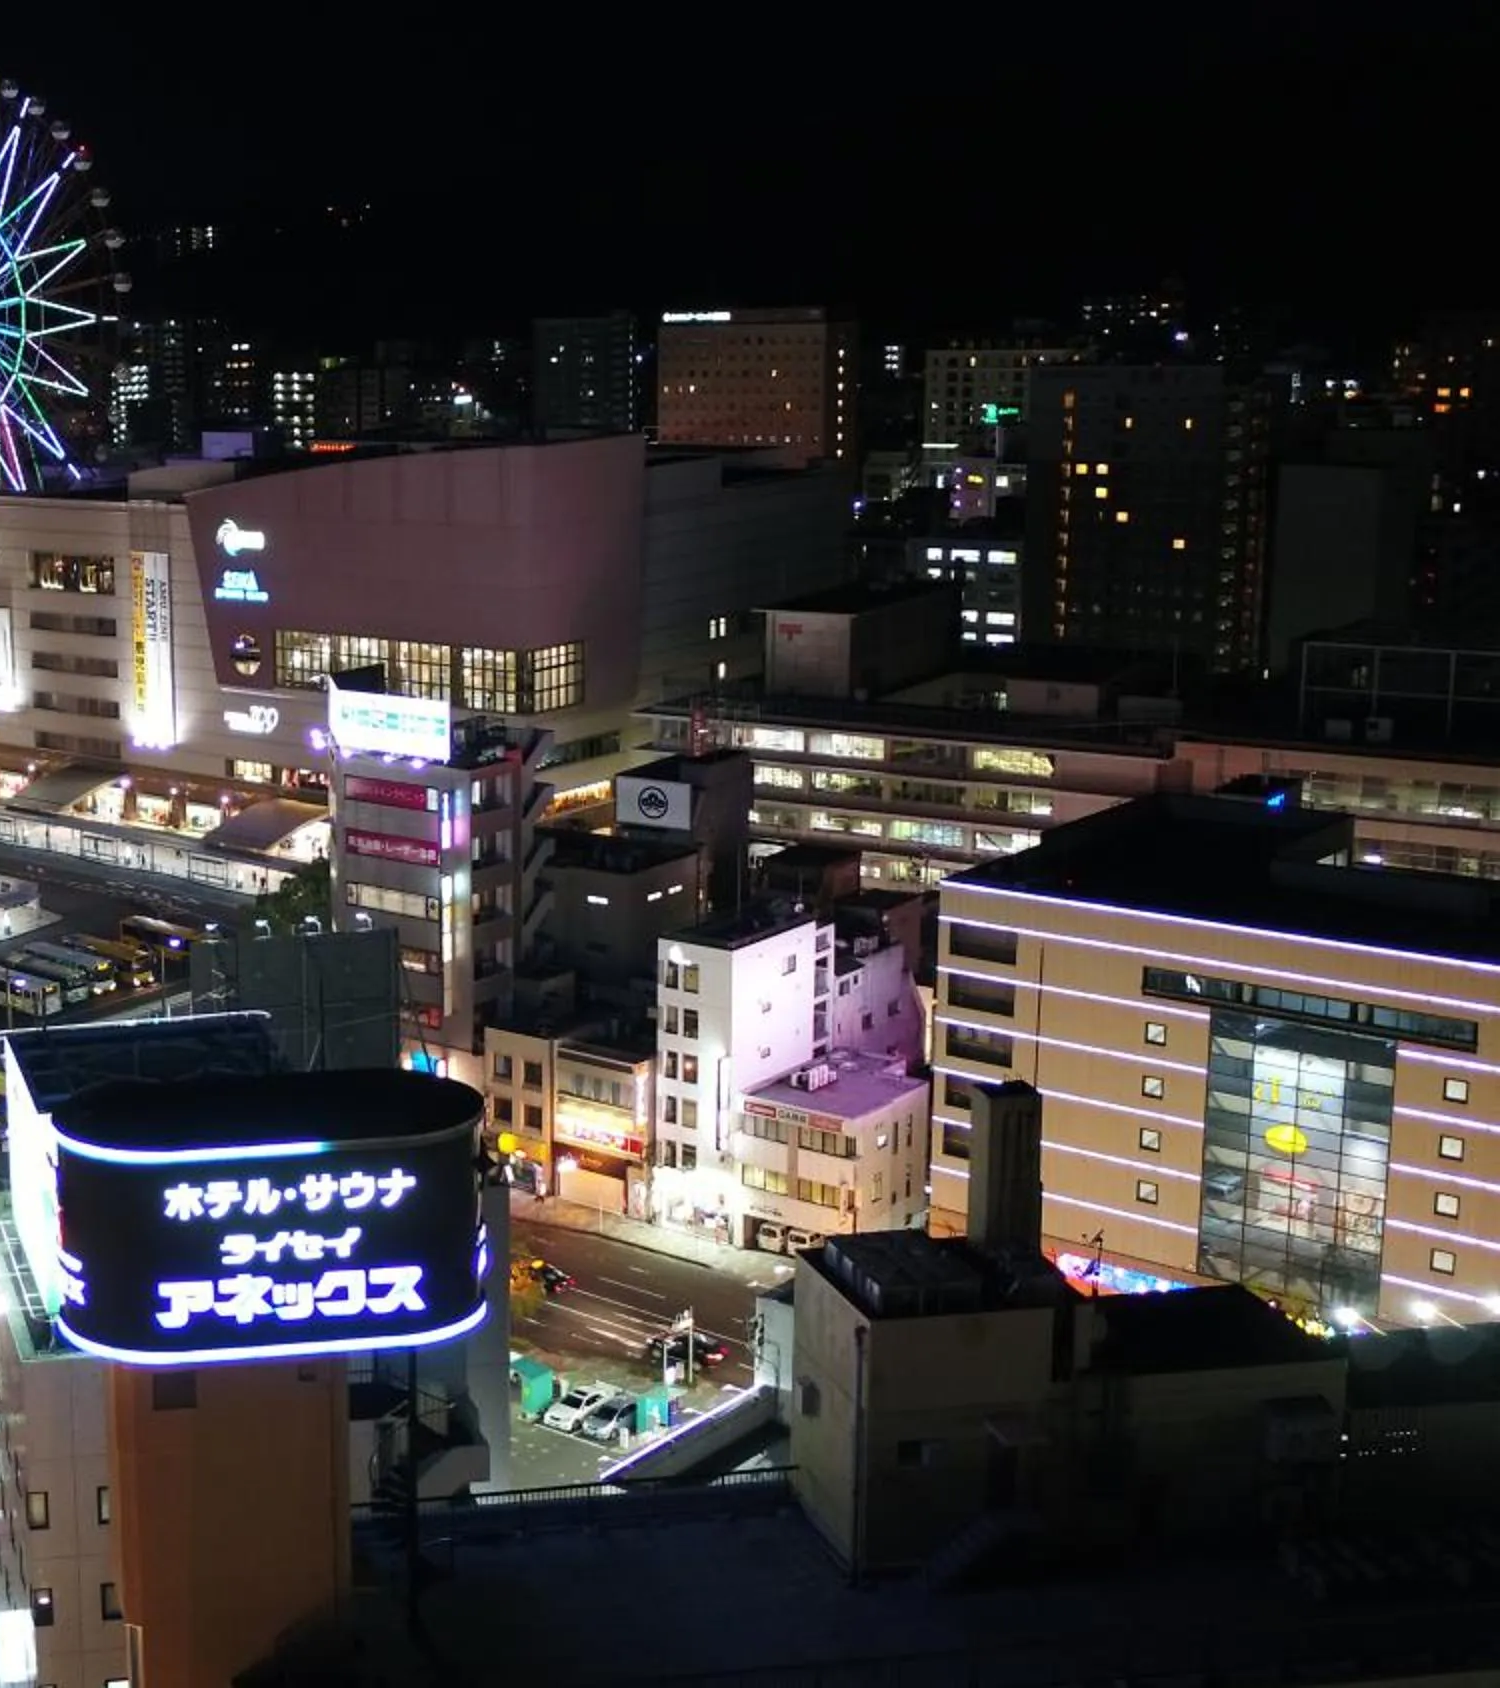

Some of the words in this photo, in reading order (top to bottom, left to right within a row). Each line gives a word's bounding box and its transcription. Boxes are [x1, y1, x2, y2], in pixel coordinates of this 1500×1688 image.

[164, 1167, 417, 1222] ホテル・サウナ
[155, 1265, 427, 1329] アネックス
